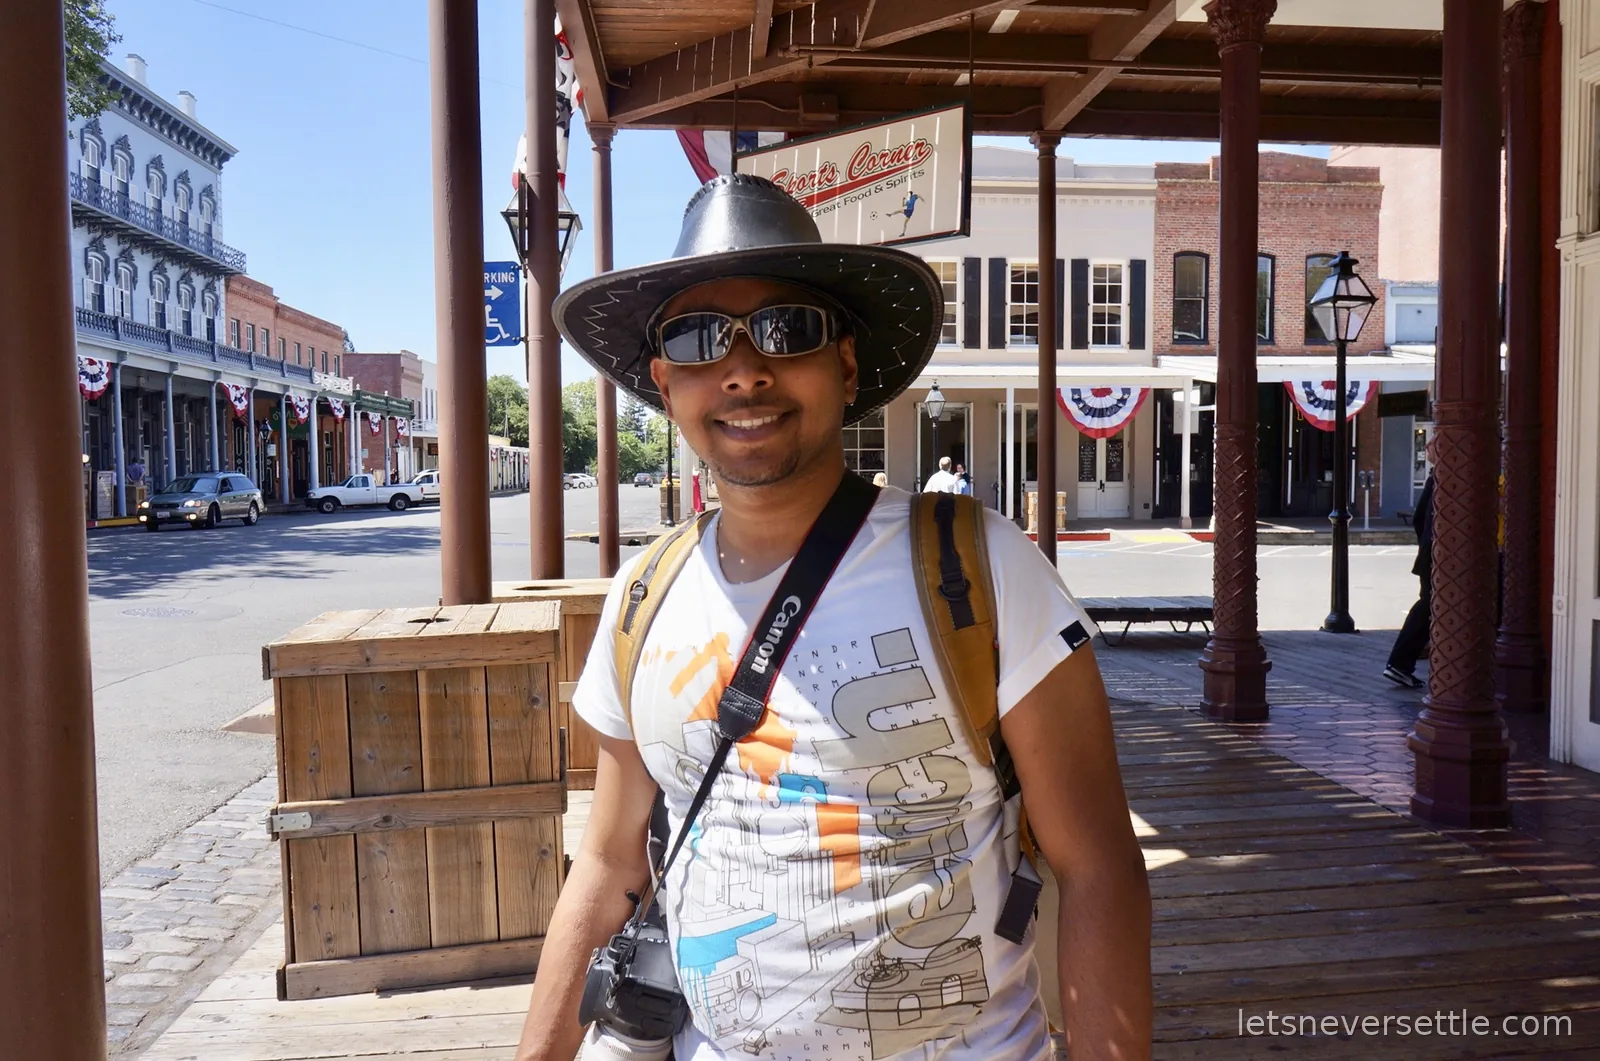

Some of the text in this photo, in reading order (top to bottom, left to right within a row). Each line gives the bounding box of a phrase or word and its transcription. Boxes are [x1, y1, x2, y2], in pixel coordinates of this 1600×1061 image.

[846, 138, 933, 182] Corner
[811, 202, 841, 218] Great
[844, 190, 872, 205] Food
[874, 183, 884, 194] &
[886, 168, 925, 190] Spirits
[484, 272, 515, 284] RKING
[751, 595, 801, 675] Canon
